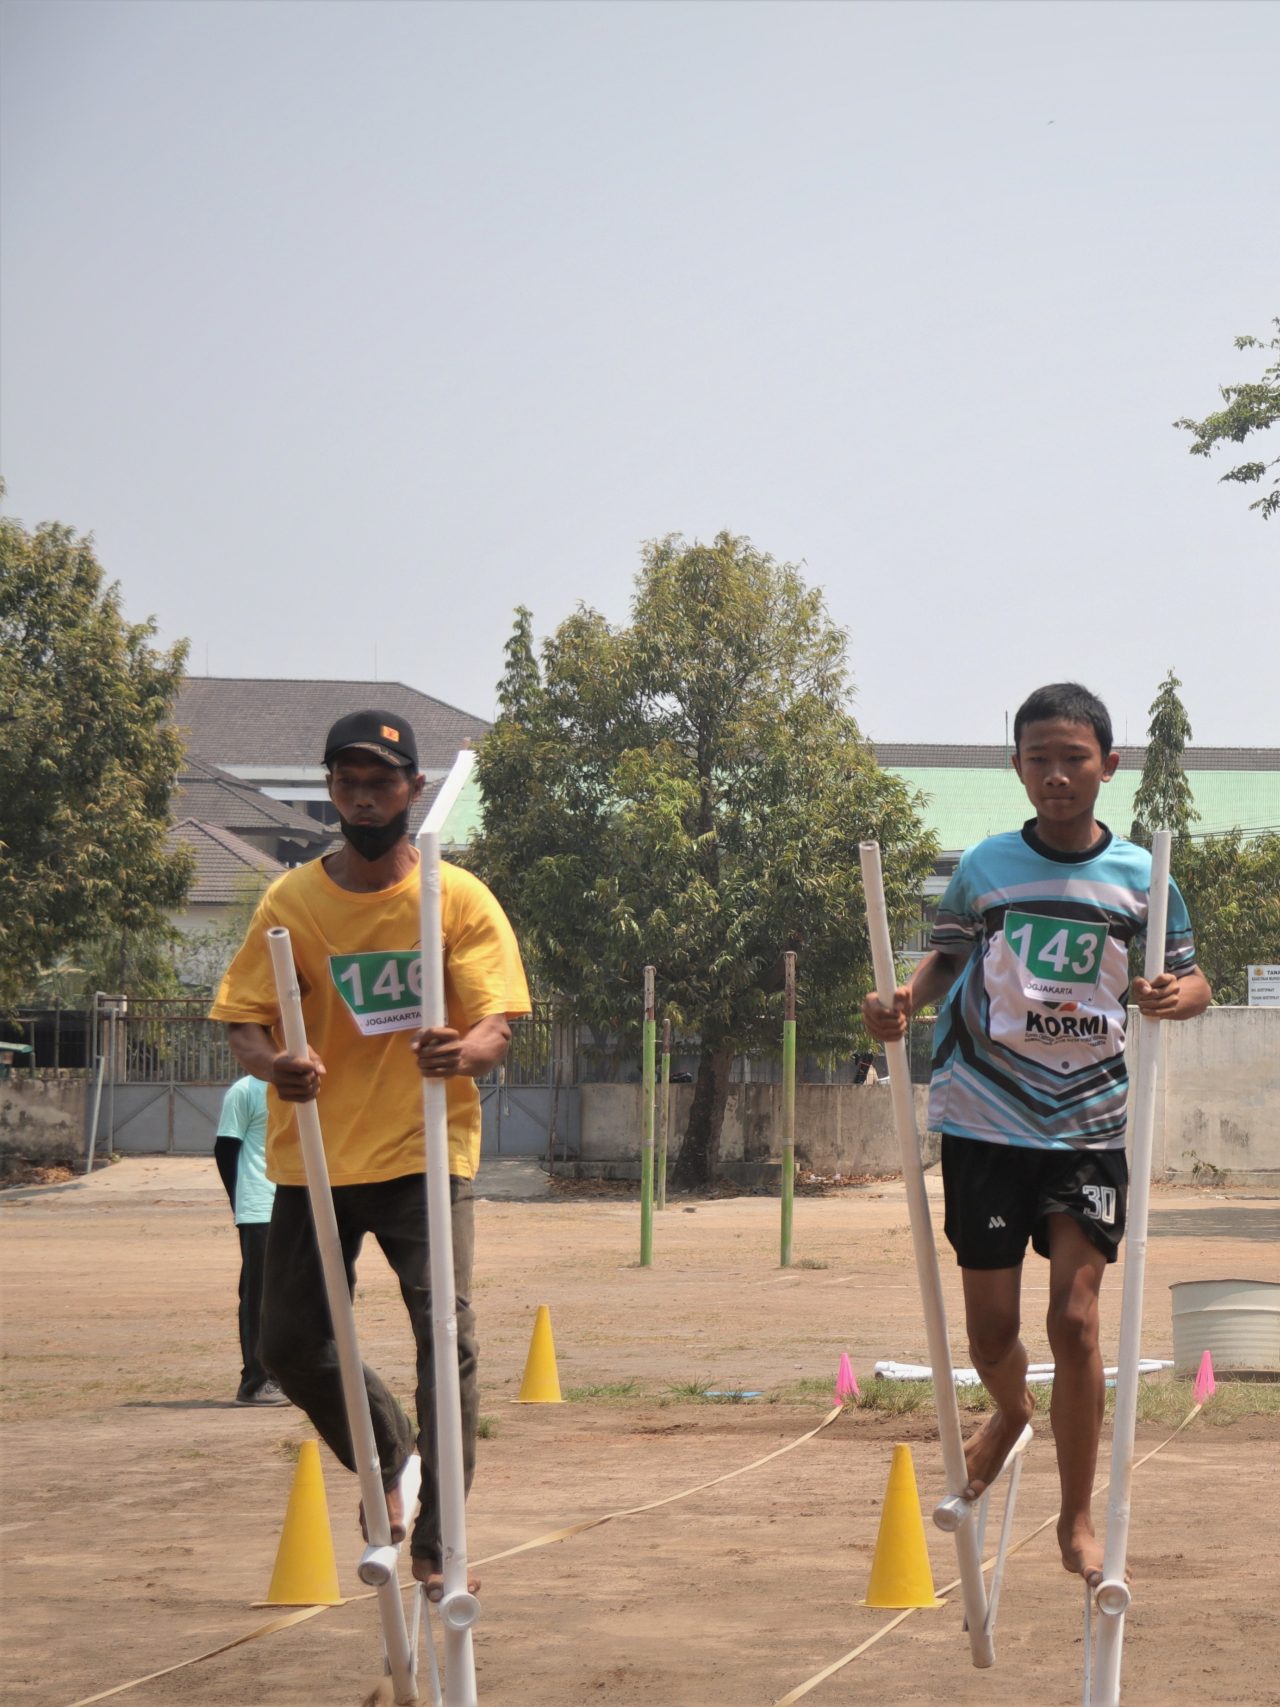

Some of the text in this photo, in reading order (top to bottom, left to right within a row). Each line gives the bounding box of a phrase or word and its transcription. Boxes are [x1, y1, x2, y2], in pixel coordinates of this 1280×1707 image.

[1011, 923, 1098, 975] 143
[1024, 983, 1073, 995] OGJAKARTA
[365, 1011, 422, 1027] JOGJAKARTA
[1026, 1010, 1108, 1037] KORMI
[1082, 1185, 1116, 1224] 30
